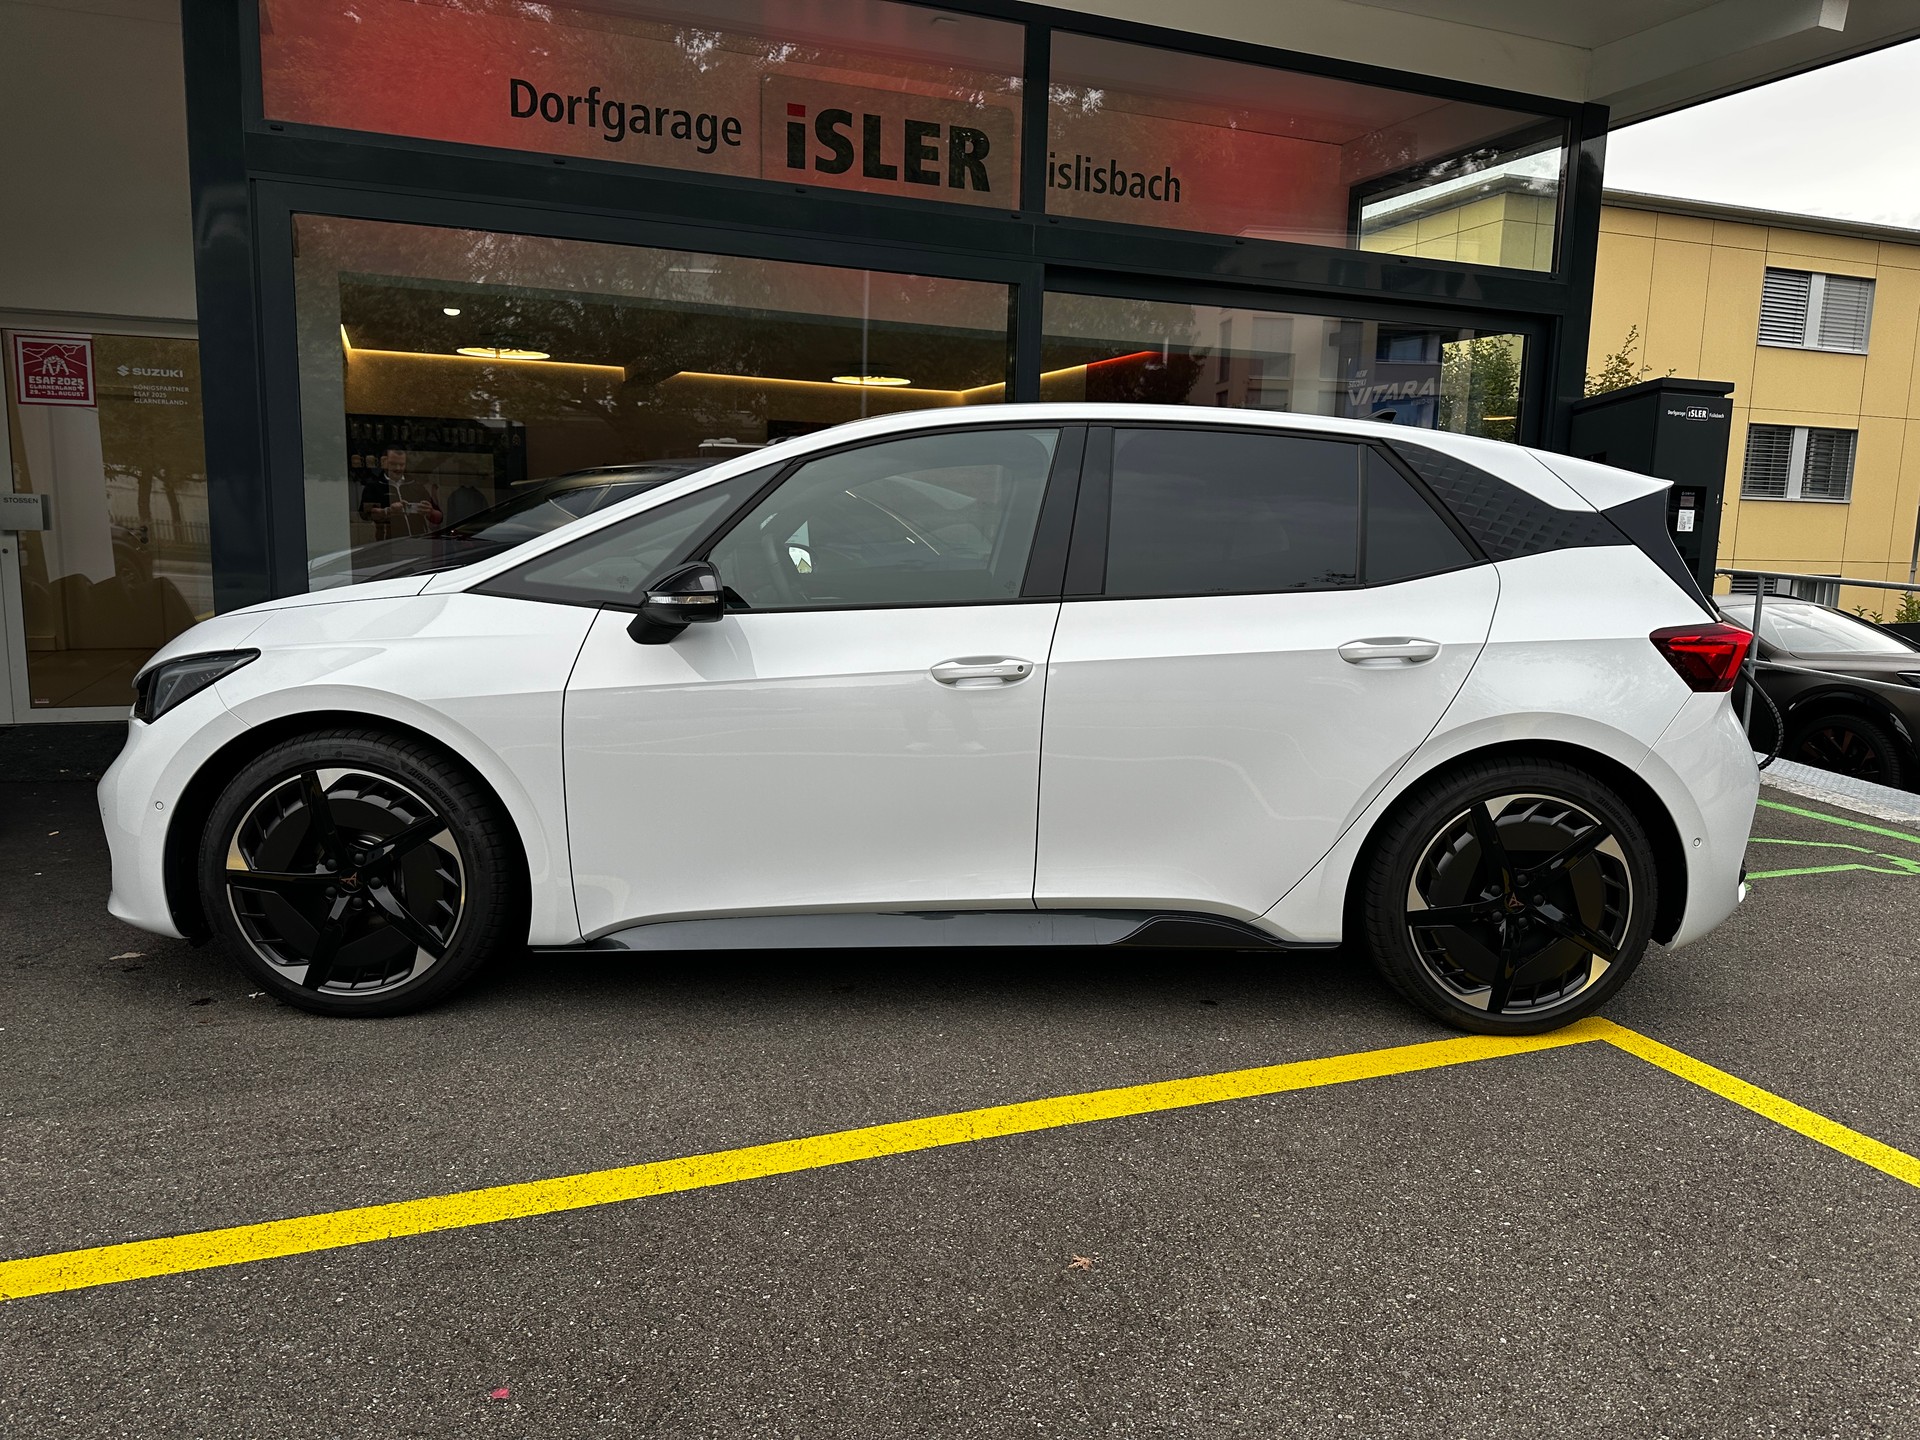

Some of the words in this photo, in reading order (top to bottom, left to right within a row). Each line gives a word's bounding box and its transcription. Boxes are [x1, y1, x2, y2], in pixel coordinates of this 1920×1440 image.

[510, 78, 742, 154] Dorfgarage
[786, 102, 991, 192] iSLER
[1048, 152, 1181, 204] islisbach
[132, 367, 184, 378] SUZUKI
[28, 375, 56, 385] ESAF
[57, 377, 84, 386] 2025
[133, 383, 190, 393] KÖNIGSPARTNER
[1347, 377, 1436, 406] VITARA
[3, 496, 39, 504] STOSSEN
[407, 767, 460, 815] BRIDGESTONE
